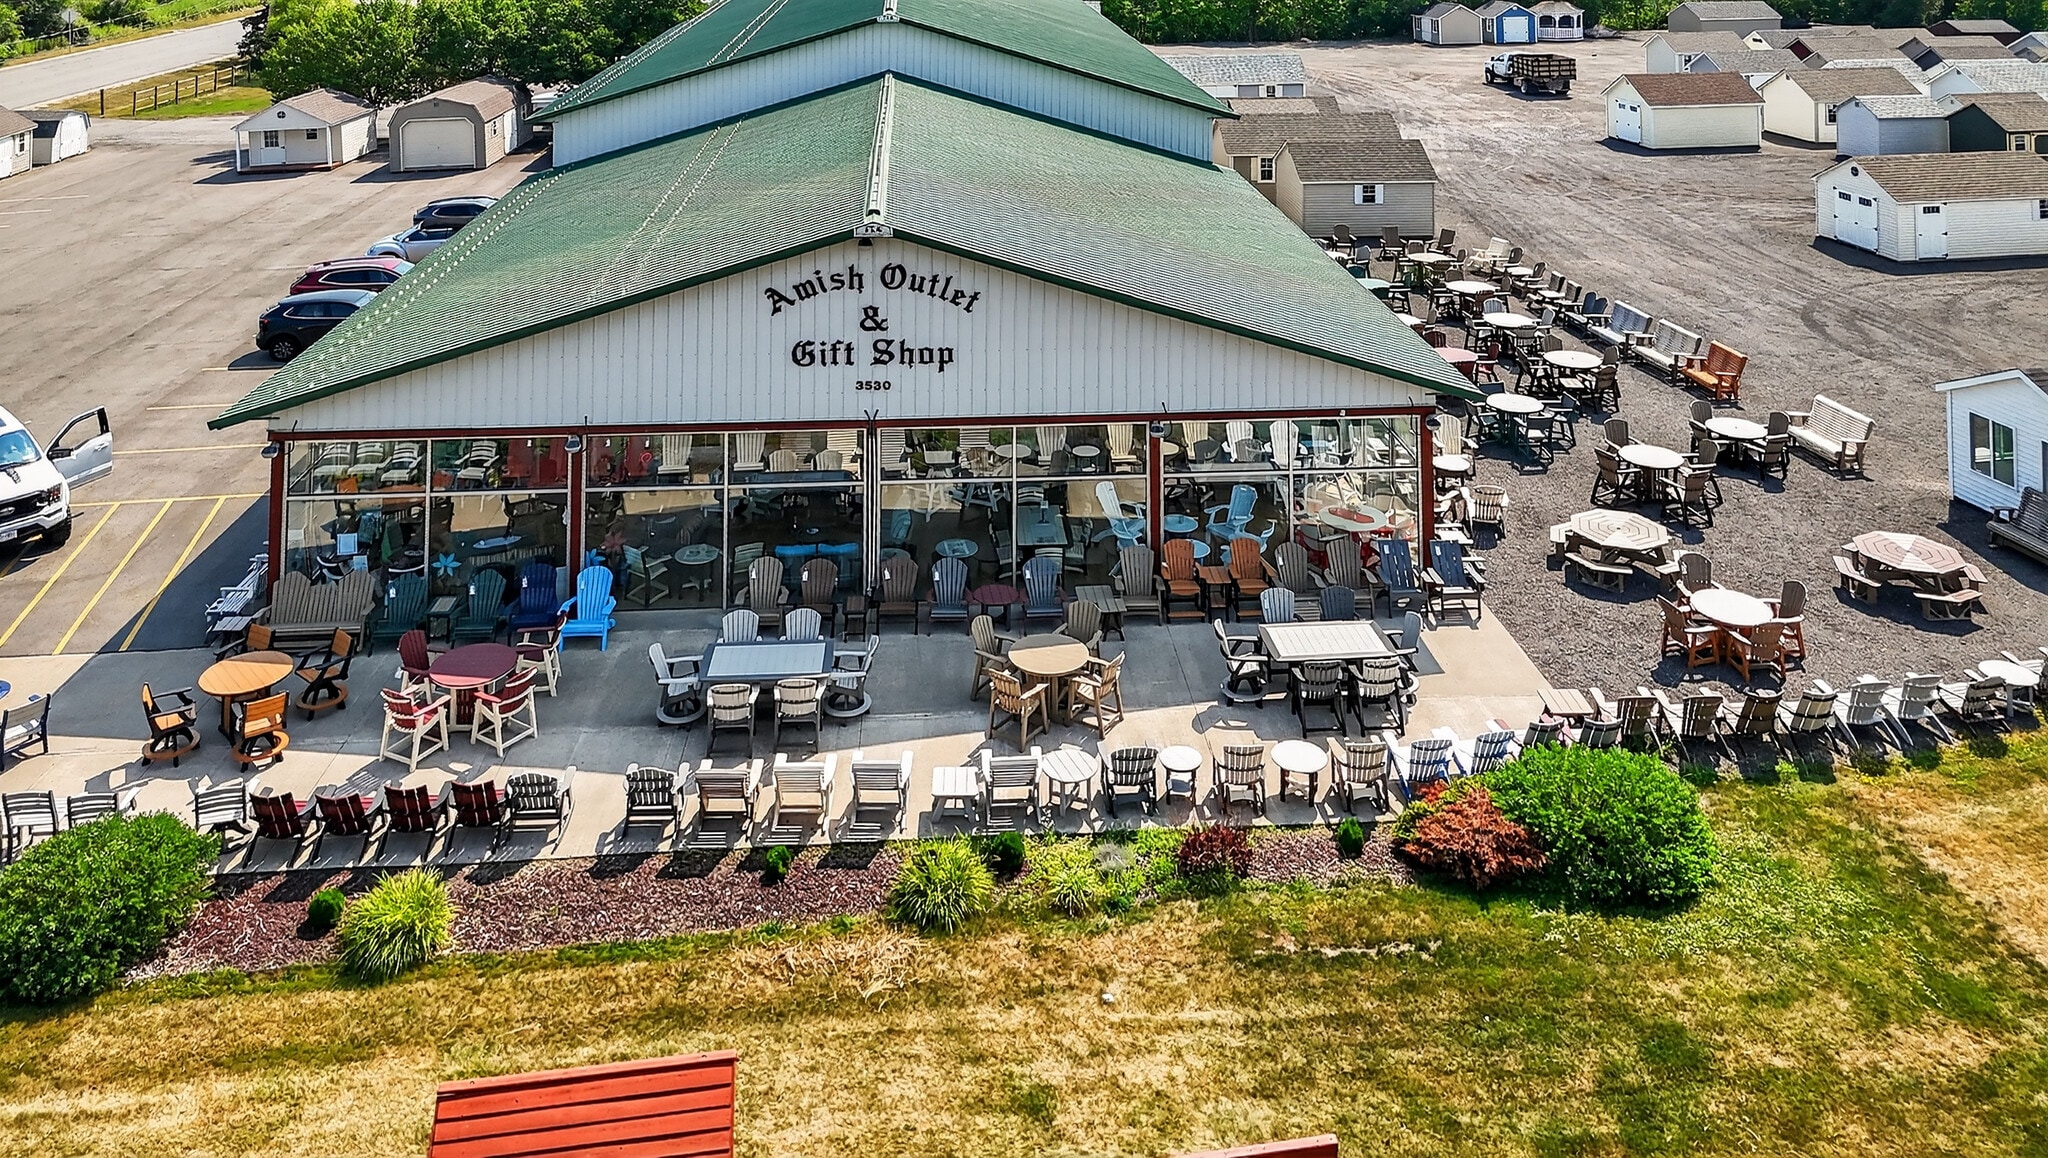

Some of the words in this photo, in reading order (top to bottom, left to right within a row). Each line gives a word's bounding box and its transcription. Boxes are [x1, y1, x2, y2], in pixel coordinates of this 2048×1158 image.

[764, 263, 865, 316] Amish
[880, 262, 981, 313] Outlet
[859, 305, 889, 332] &
[791, 340, 855, 367] Gift
[869, 338, 955, 373] Shop
[855, 380, 891, 391] 3530
